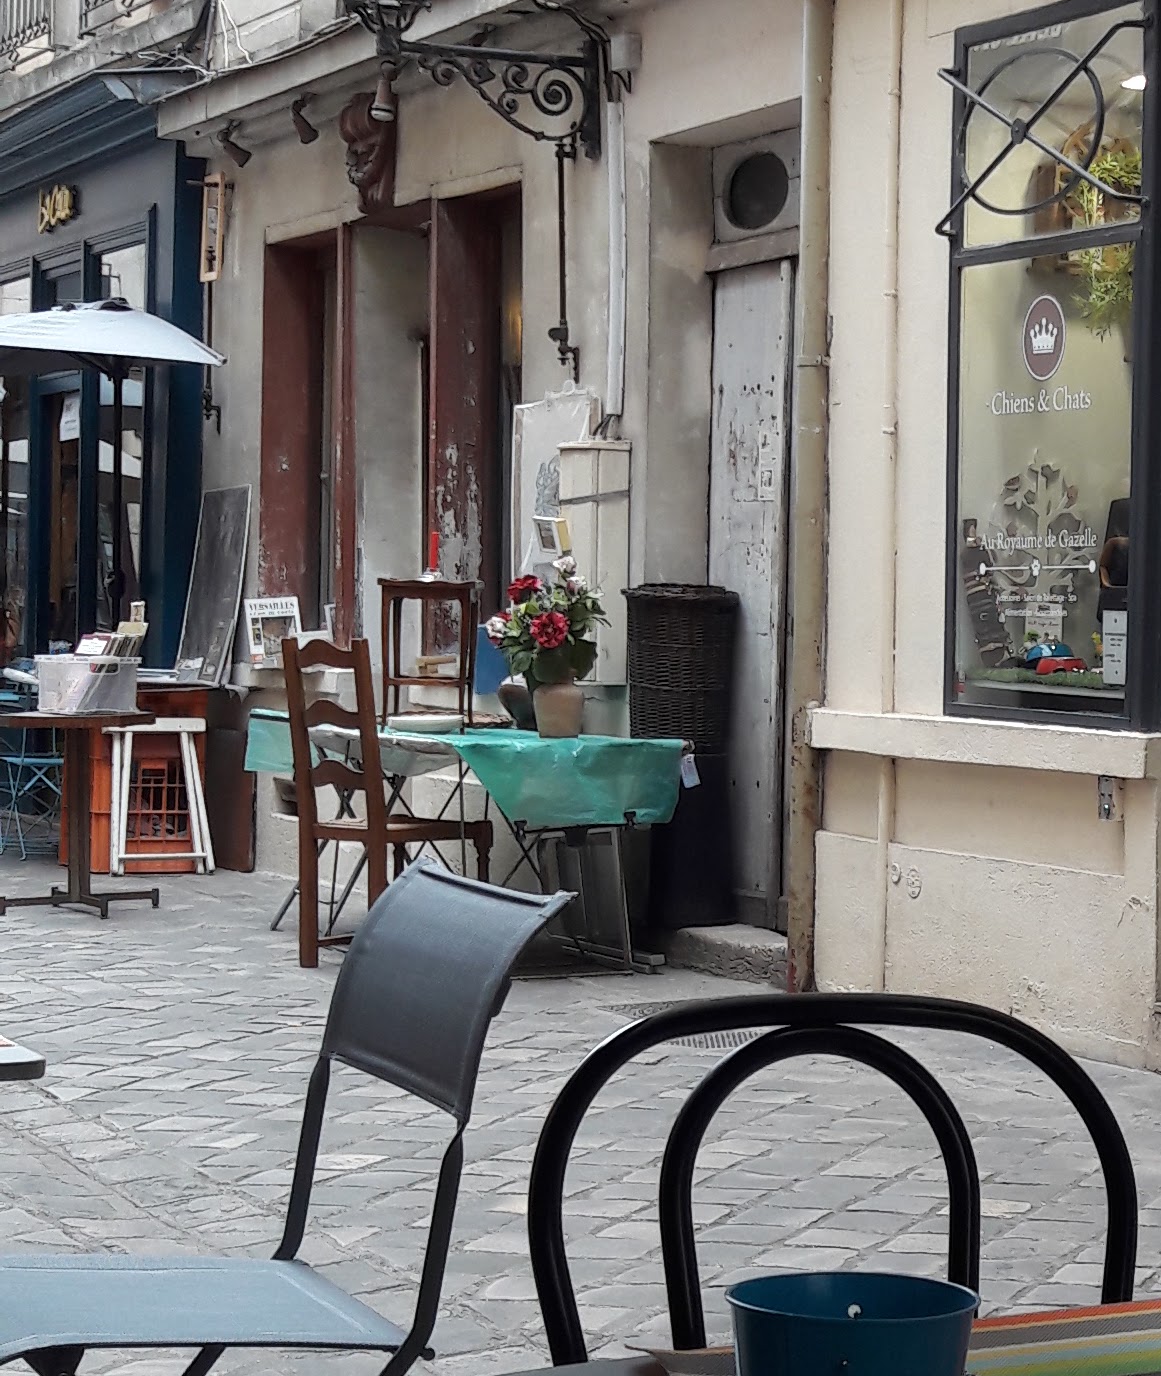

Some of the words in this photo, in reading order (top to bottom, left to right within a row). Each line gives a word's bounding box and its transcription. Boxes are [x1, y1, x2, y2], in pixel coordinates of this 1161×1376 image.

[991, 391, 1035, 415] Chiens
[1037, 389, 1050, 412] &
[1053, 385, 1091, 411] Chats
[980, 533, 995, 550] Au
[996, 532, 1042, 555] Royaume
[1045, 528, 1057, 548] de
[1059, 527, 1098, 548] Gazelle
